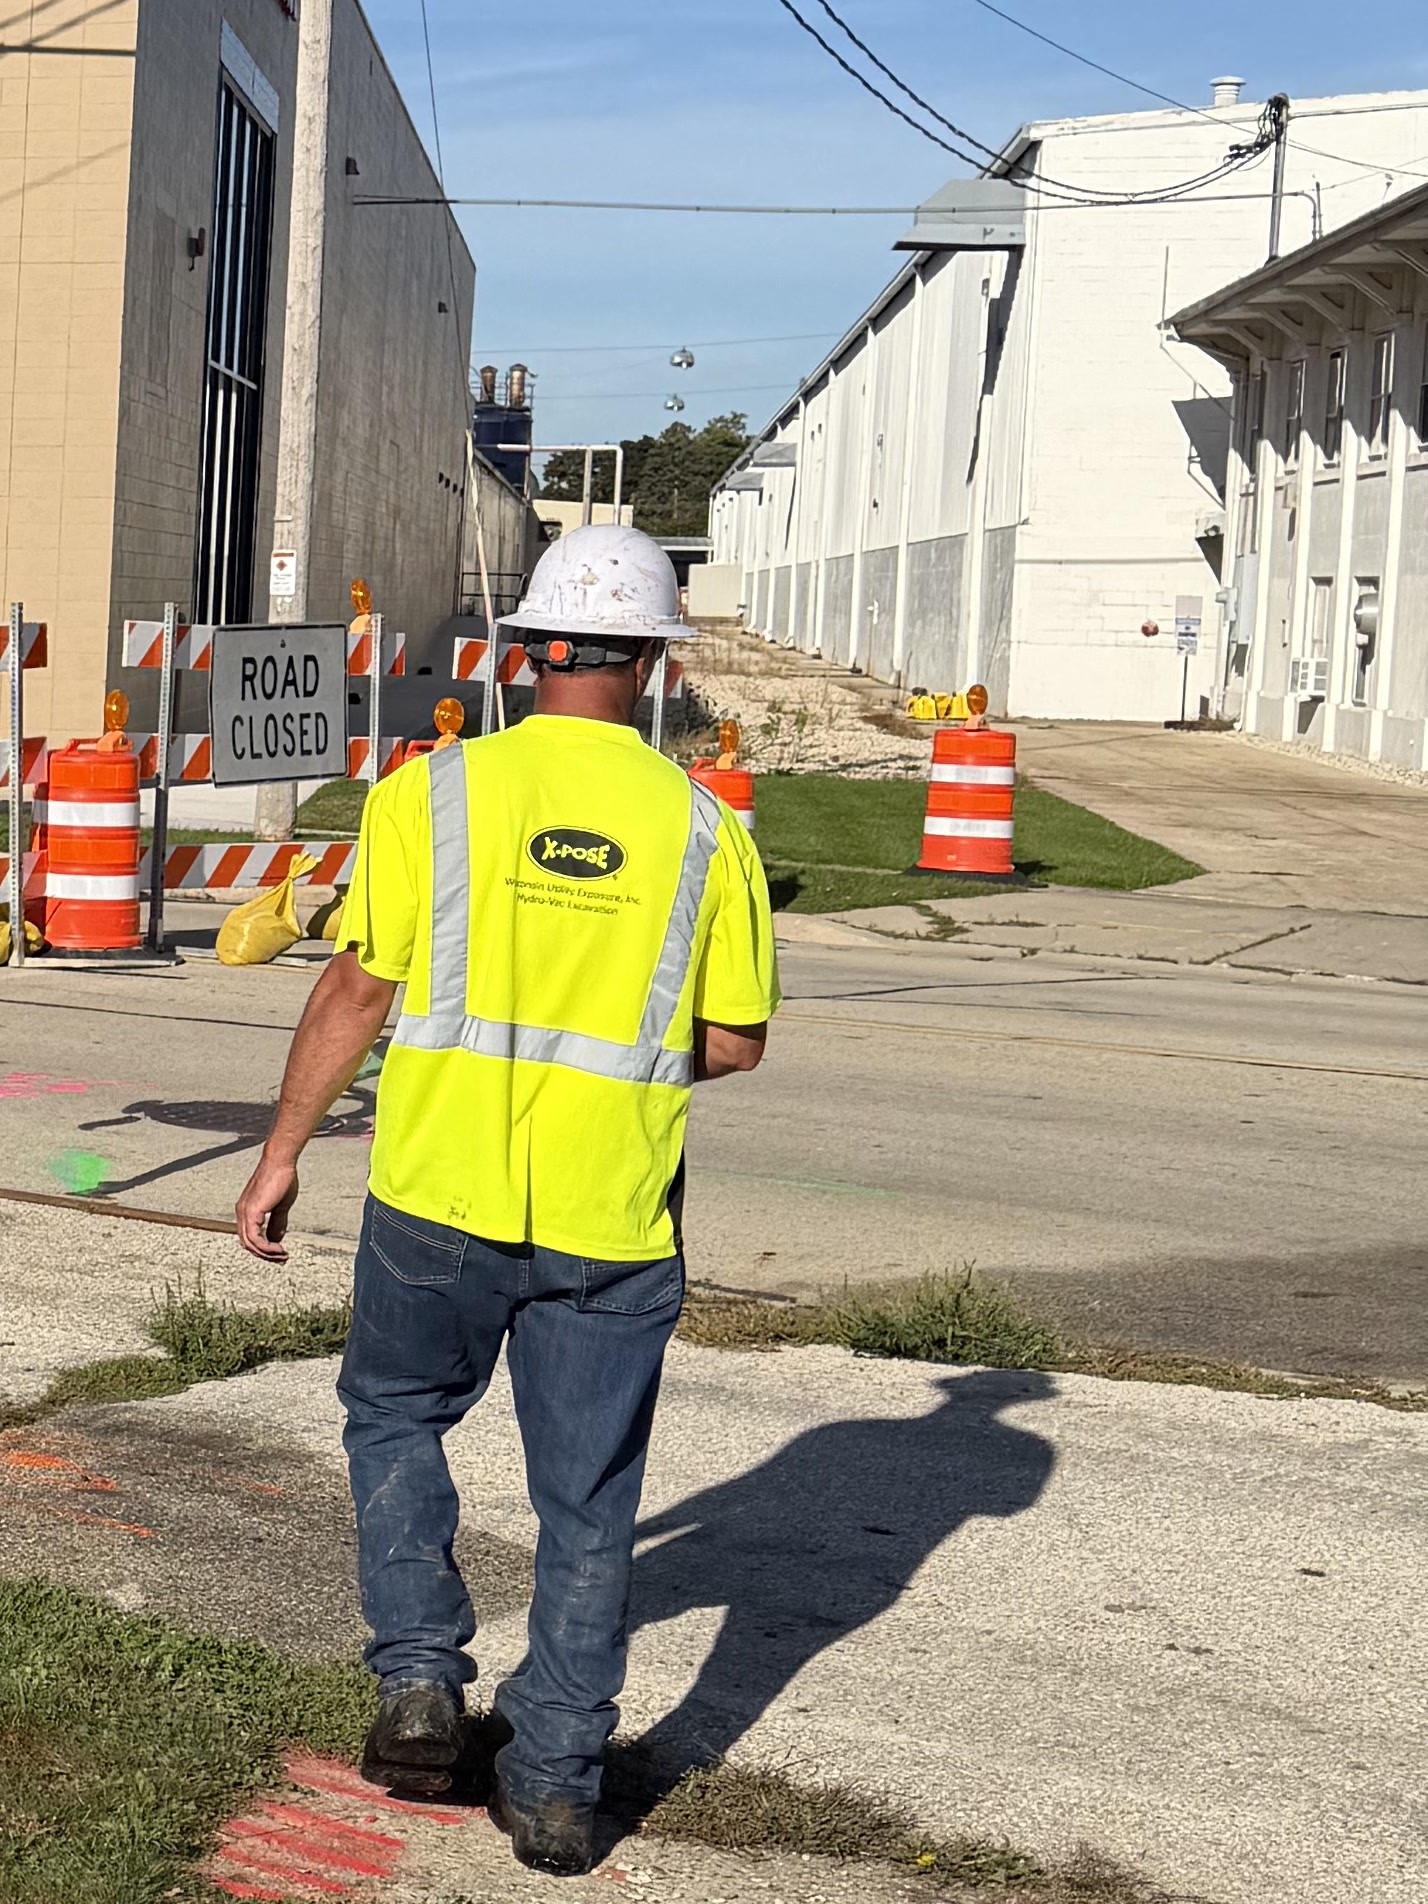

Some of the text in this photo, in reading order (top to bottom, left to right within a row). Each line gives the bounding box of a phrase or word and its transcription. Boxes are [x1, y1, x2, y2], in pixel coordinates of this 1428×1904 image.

[241, 655, 319, 701] ROAD
[232, 712, 329, 760] CLOSED
[542, 837, 611, 870] X-POSE
[505, 877, 545, 891] Wisconsin
[547, 883, 575, 897] Utility
[625, 894, 643, 906] Inc.
